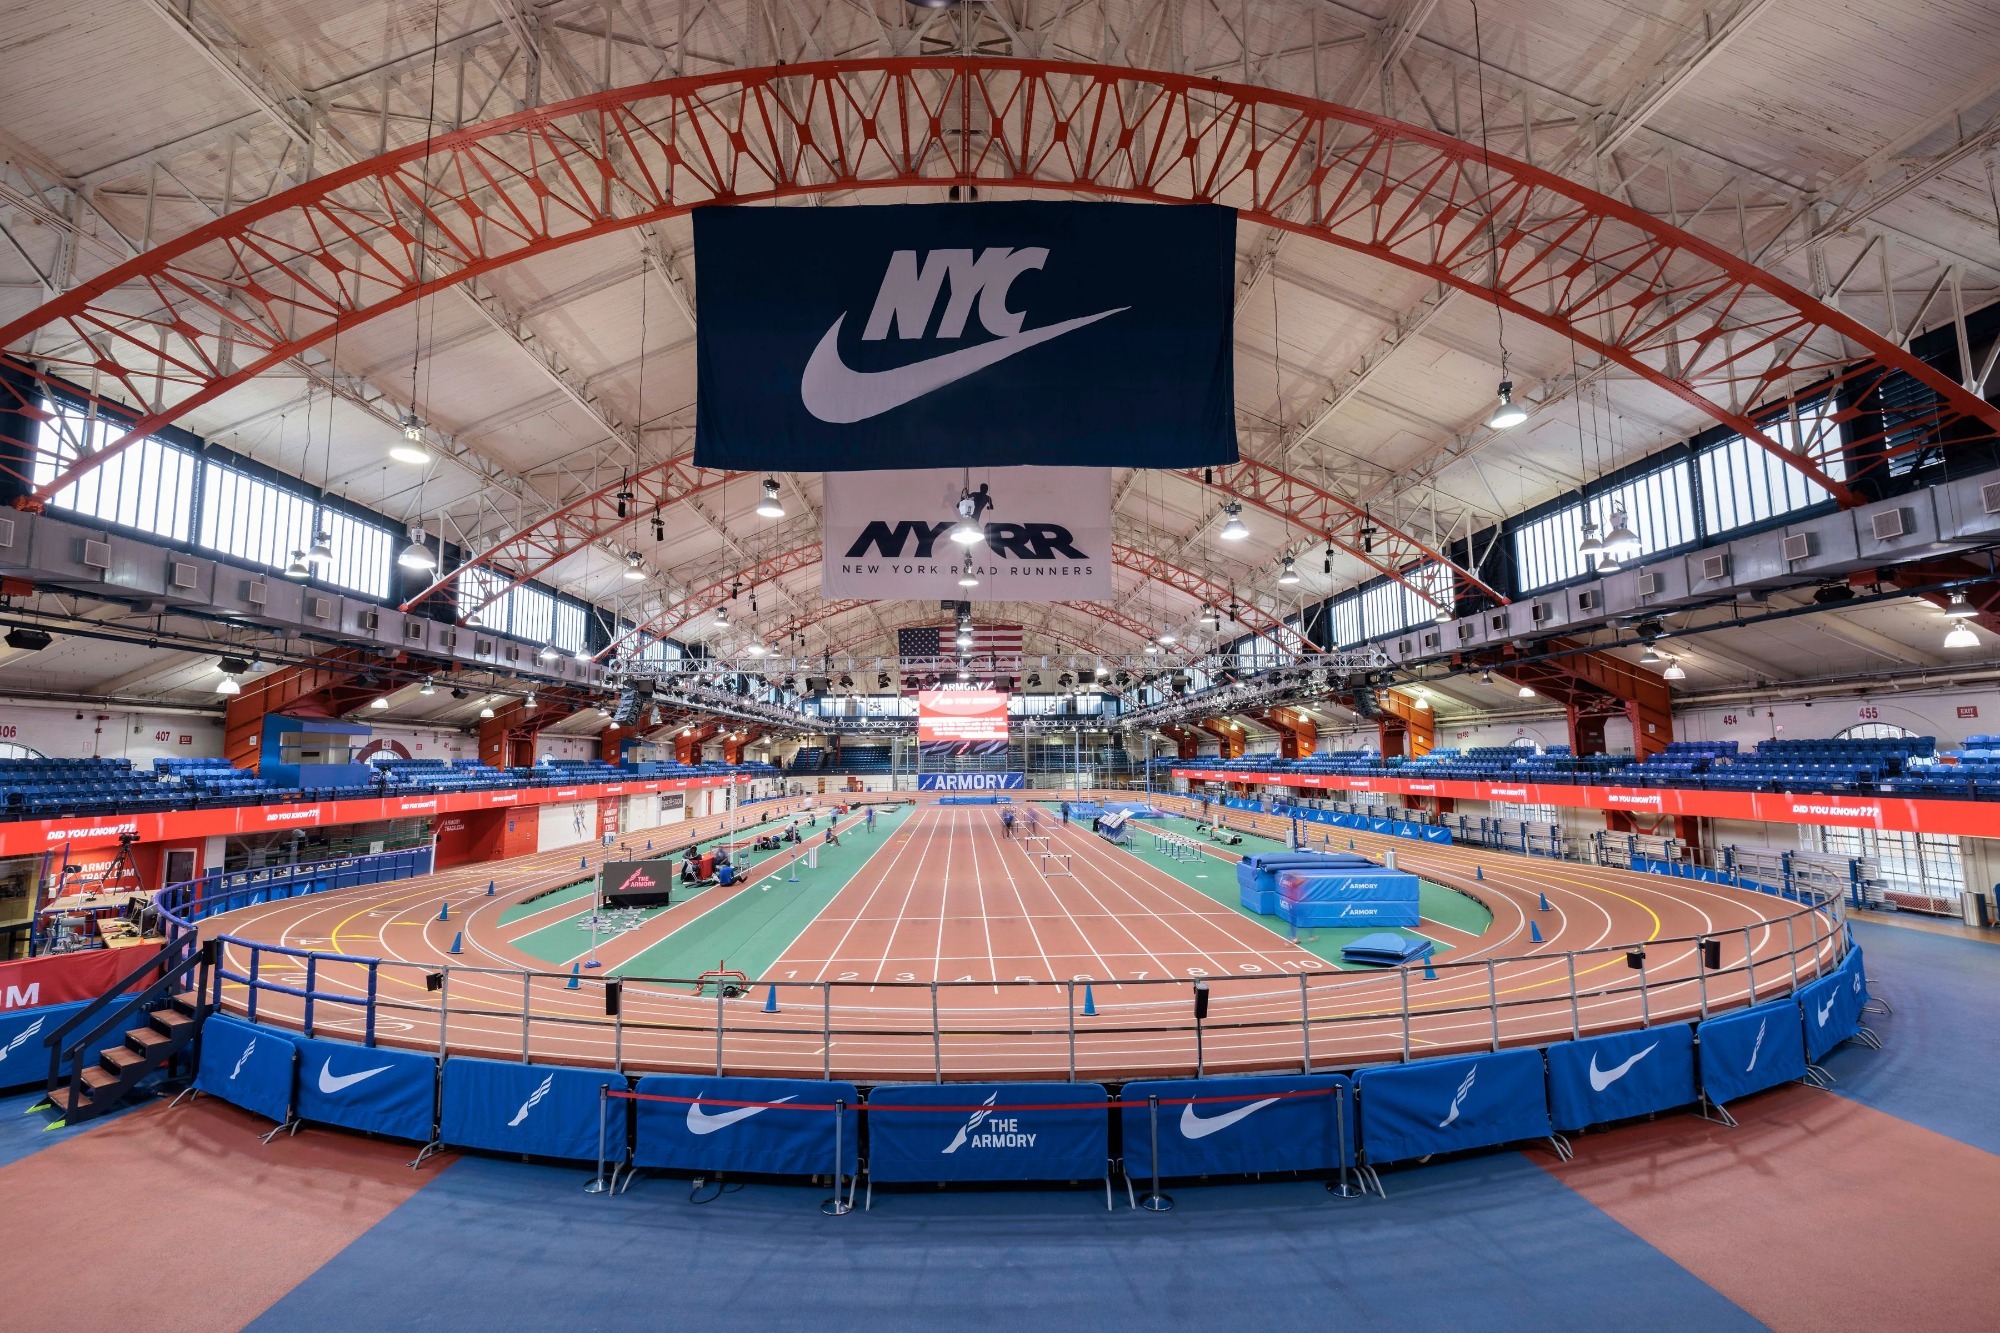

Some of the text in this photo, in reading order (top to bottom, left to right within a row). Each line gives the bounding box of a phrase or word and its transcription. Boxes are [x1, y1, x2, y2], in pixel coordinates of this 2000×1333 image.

[862, 247, 1050, 340] NYC
[842, 565, 879, 574] NEW
[892, 565, 938, 574] YORK
[1010, 566, 1093, 575] RUNNERS
[1859, 706, 1878, 719] 455
[1723, 715, 1737, 725] 454
[0, 725, 17, 738] 06
[155, 731, 170, 742] 407
[934, 775, 1008, 789] ARMORY
[1792, 804, 1809, 813] DID
[1810, 805, 1829, 815] YOU
[47, 830, 66, 840] DID
[67, 828, 88, 839] YOU
[784, 970, 798, 979] 1
[836, 971, 859, 981] 2
[895, 972, 916, 982] 3
[1129, 971, 1149, 980] 7
[1186, 967, 1209, 977] 8
[1238, 963, 1262, 973] 9
[1282, 960, 1323, 969] 10
[989, 1118, 1018, 1133] THE
[971, 1133, 1037, 1148] ARMORY
